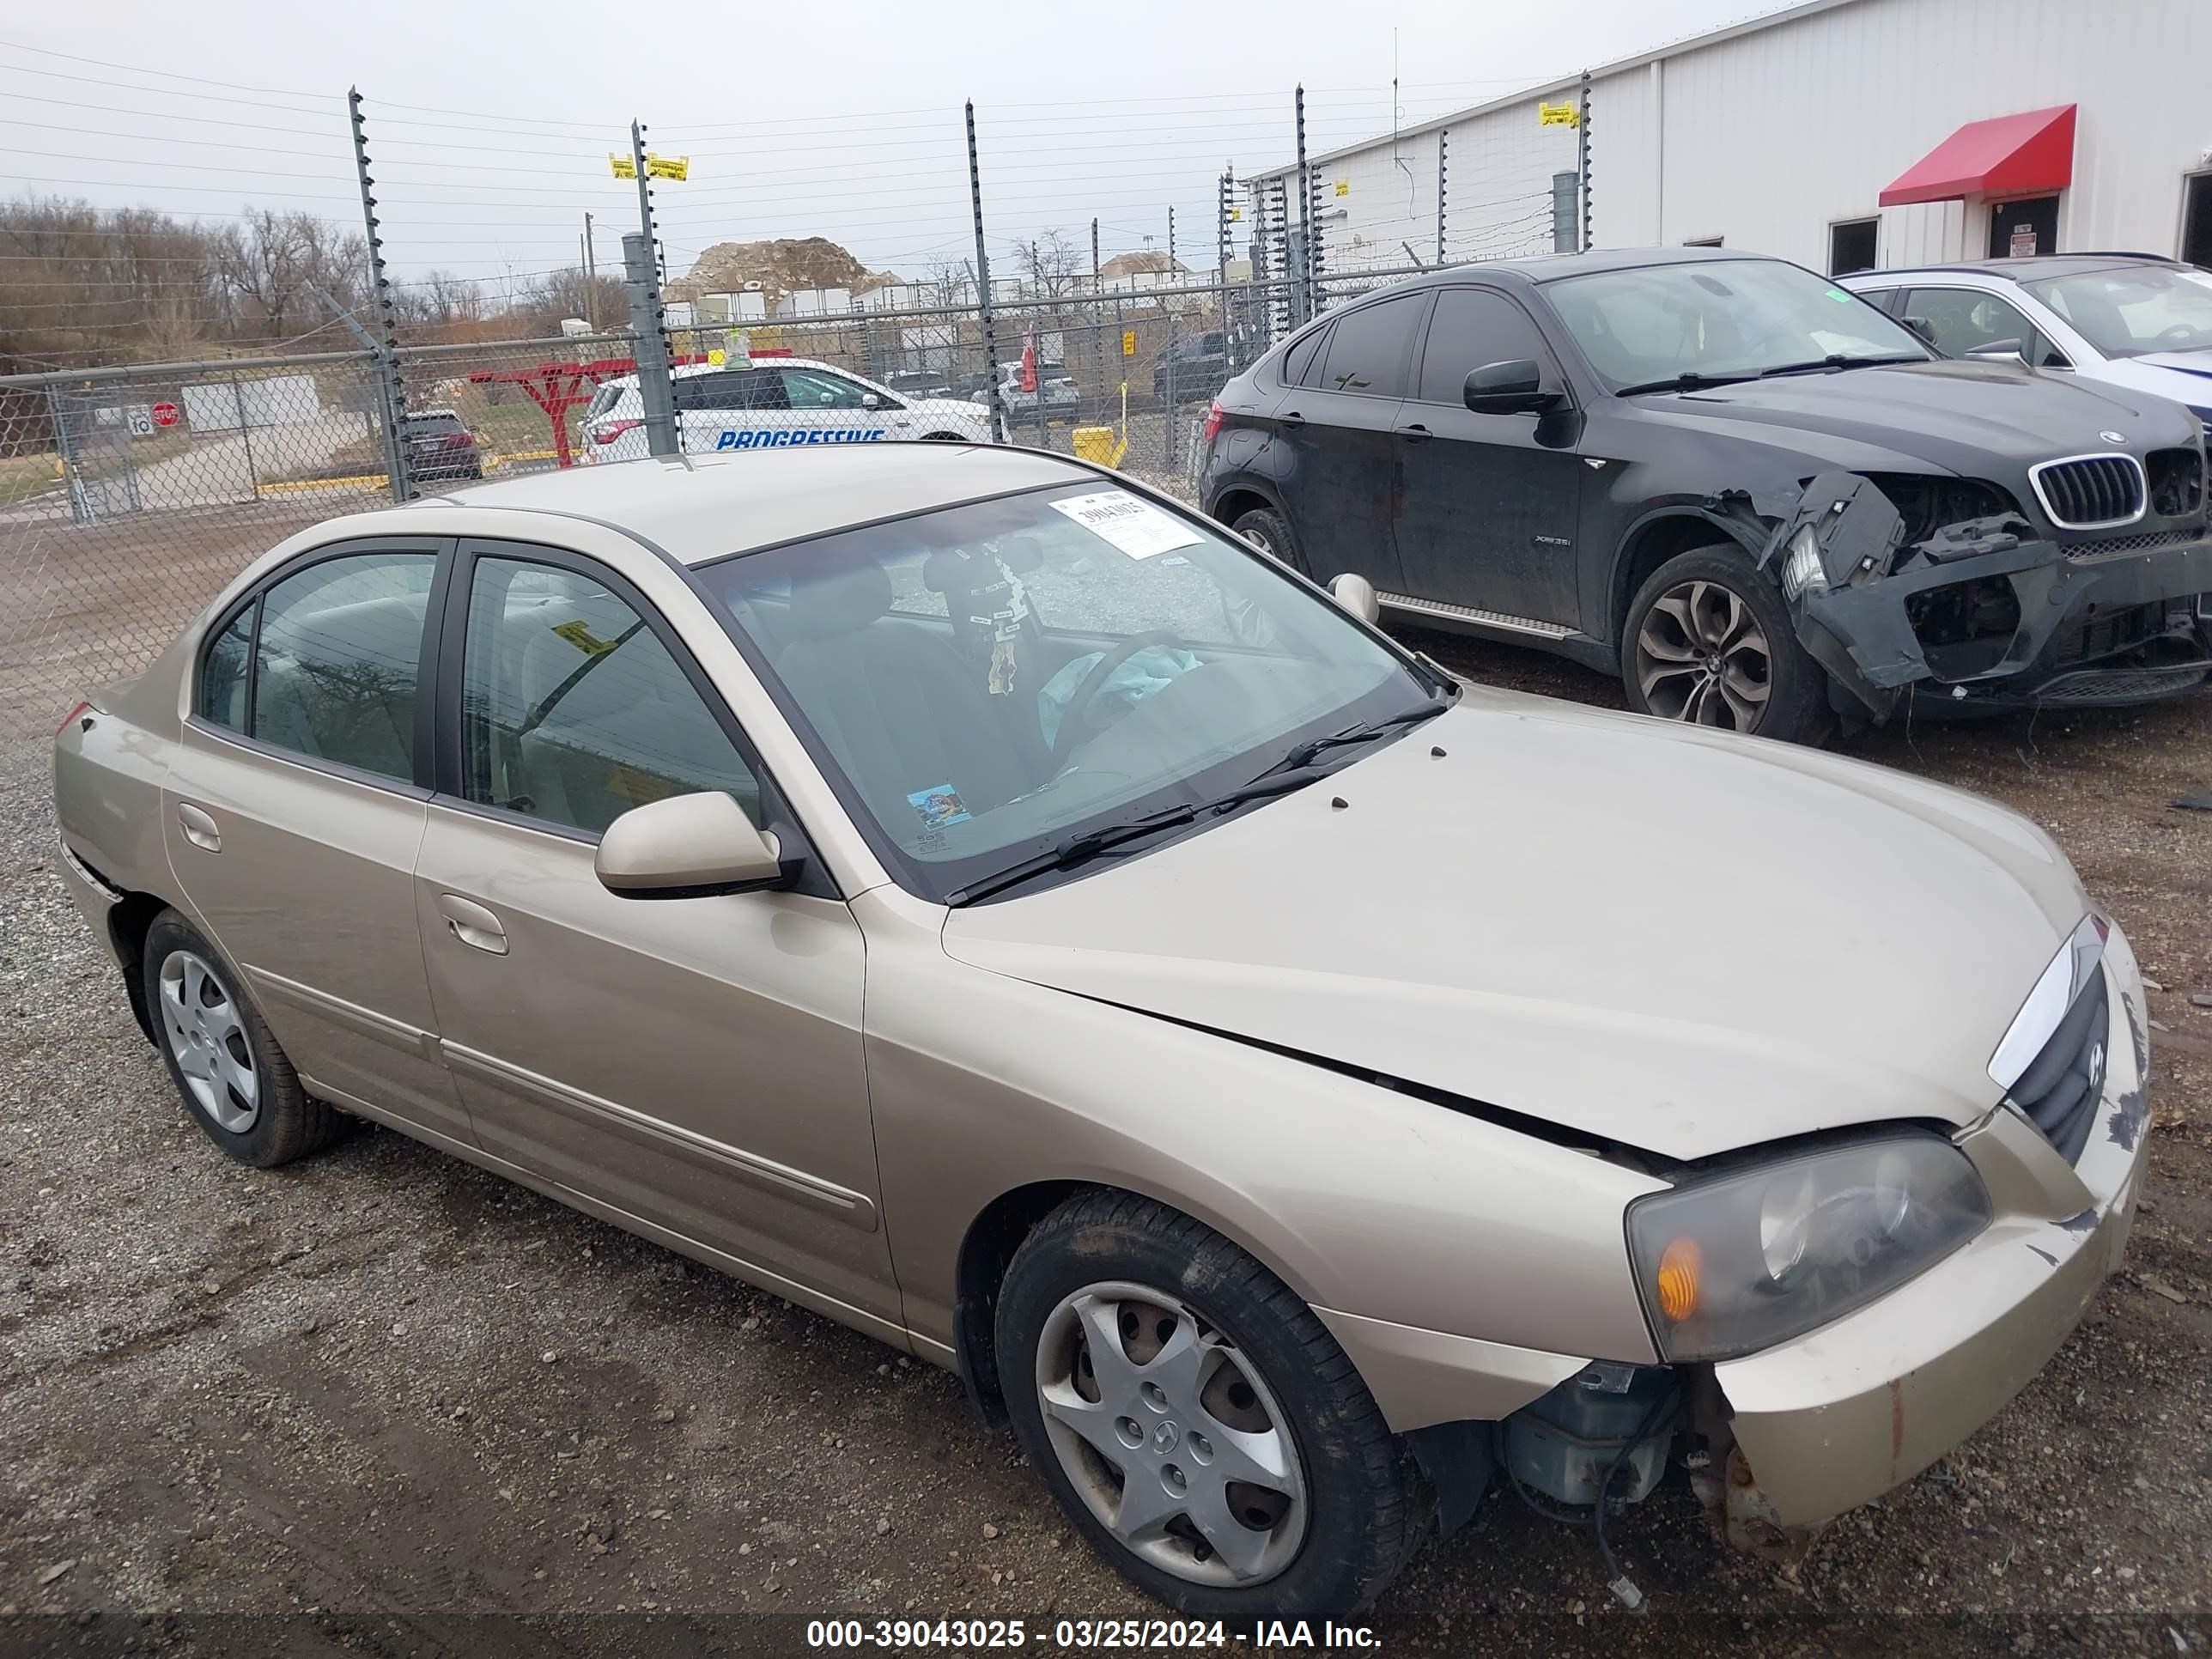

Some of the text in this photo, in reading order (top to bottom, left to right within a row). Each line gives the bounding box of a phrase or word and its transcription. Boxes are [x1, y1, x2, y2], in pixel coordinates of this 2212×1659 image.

[154, 409, 179, 419] STOP
[132, 420, 149, 433] 10
[1079, 502, 1146, 523] 39043025
